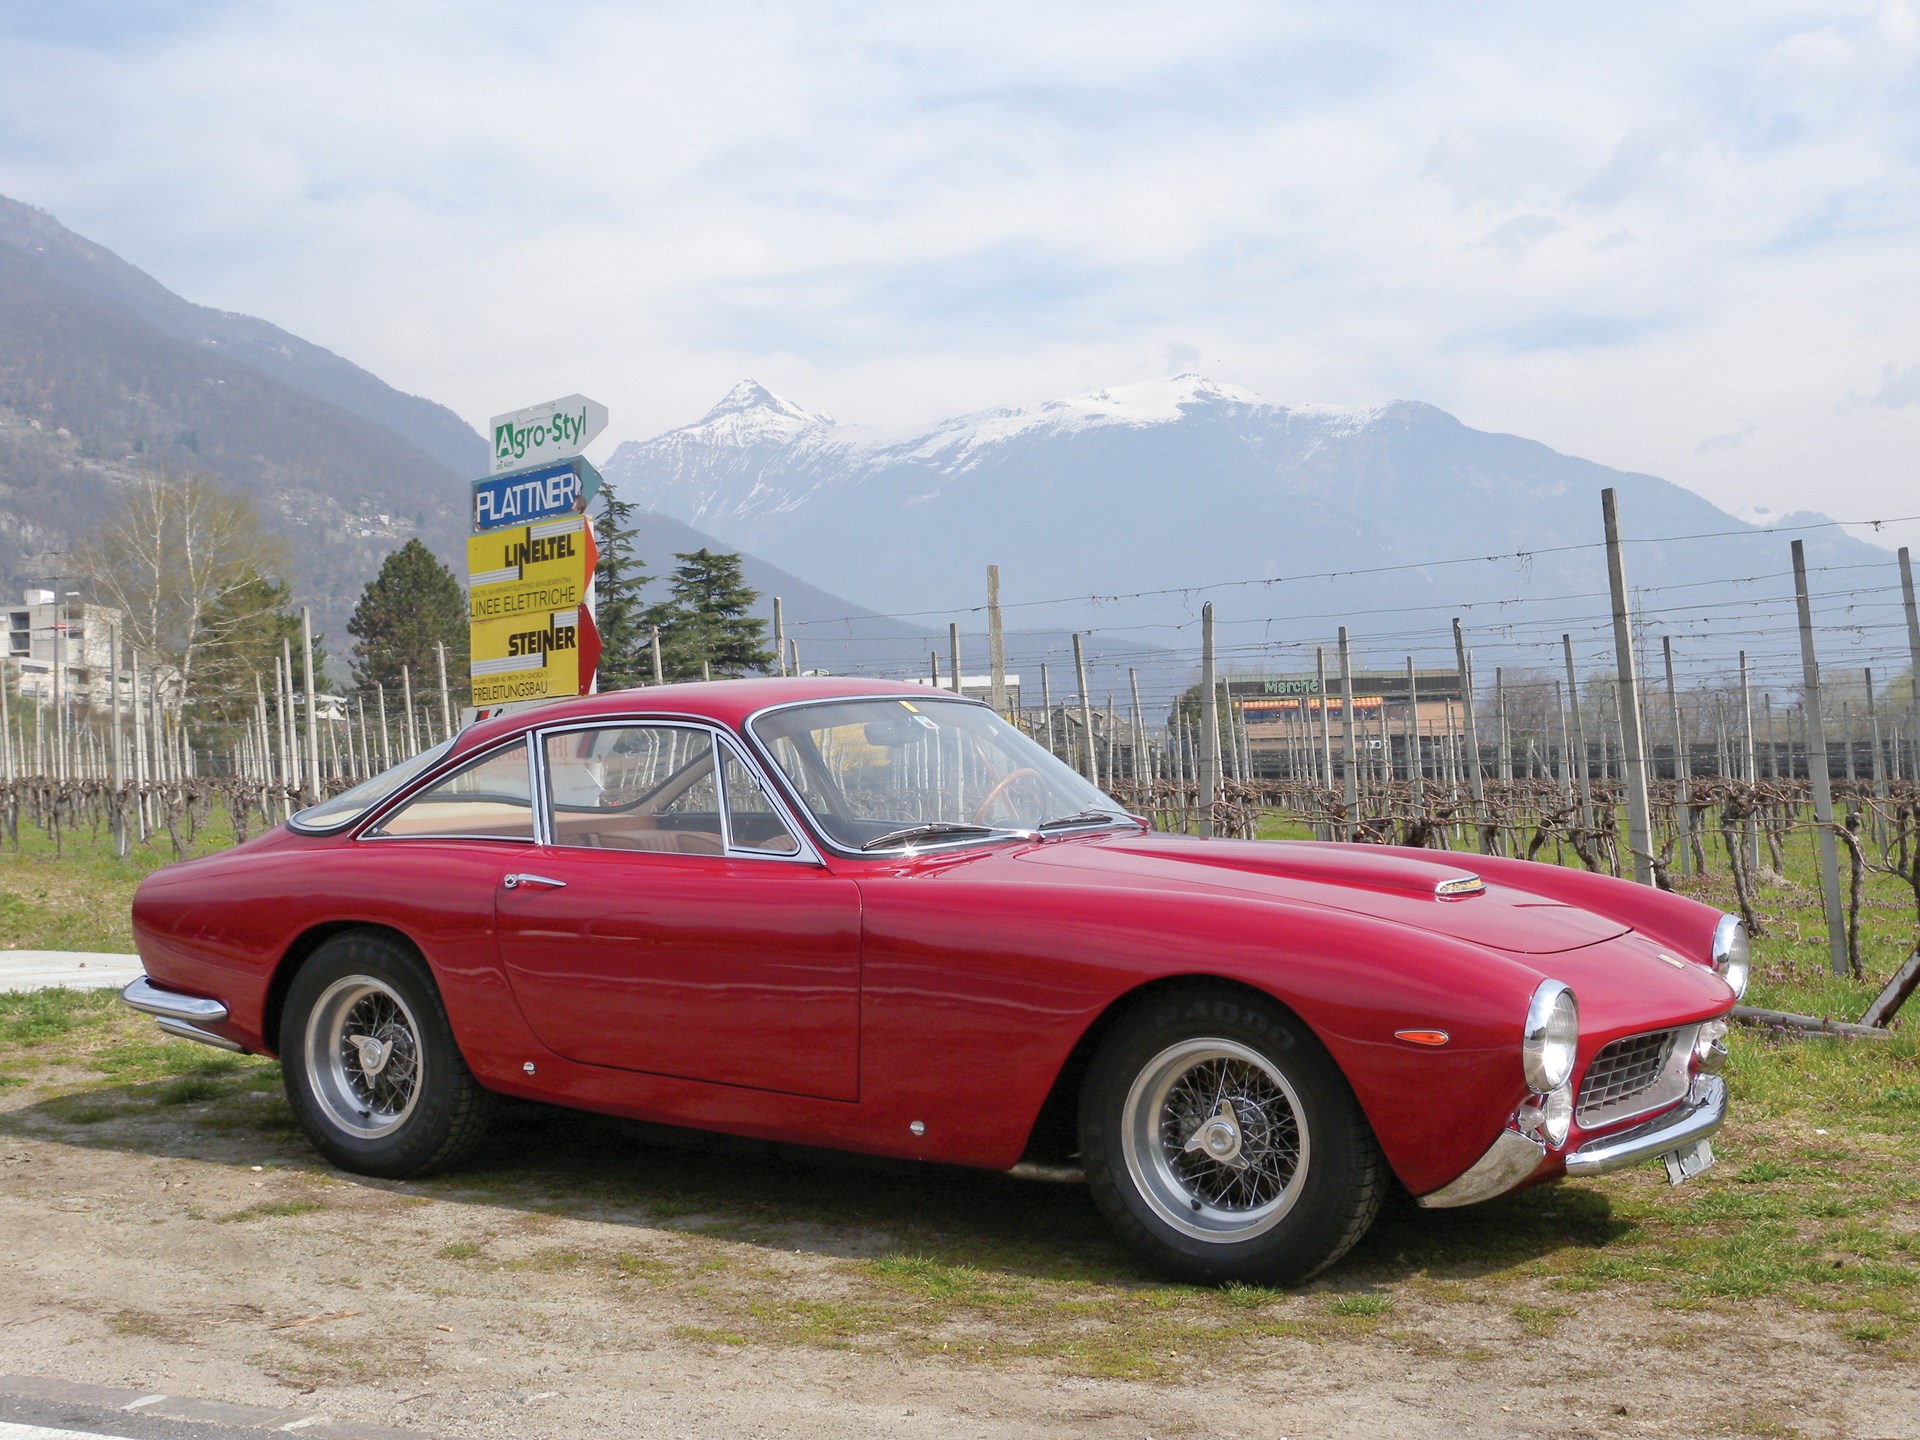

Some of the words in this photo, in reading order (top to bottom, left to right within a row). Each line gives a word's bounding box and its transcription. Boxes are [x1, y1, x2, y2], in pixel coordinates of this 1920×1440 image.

[496, 405, 587, 459] Agro-Styl
[476, 472, 576, 523] PLATTNER
[504, 527, 576, 580] LINELTEL
[470, 597, 500, 618] LINEE
[504, 585, 576, 612] ELETTRICHE
[508, 613, 577, 667] STEINER
[473, 680, 549, 701] FREILEITUNGSBAU
